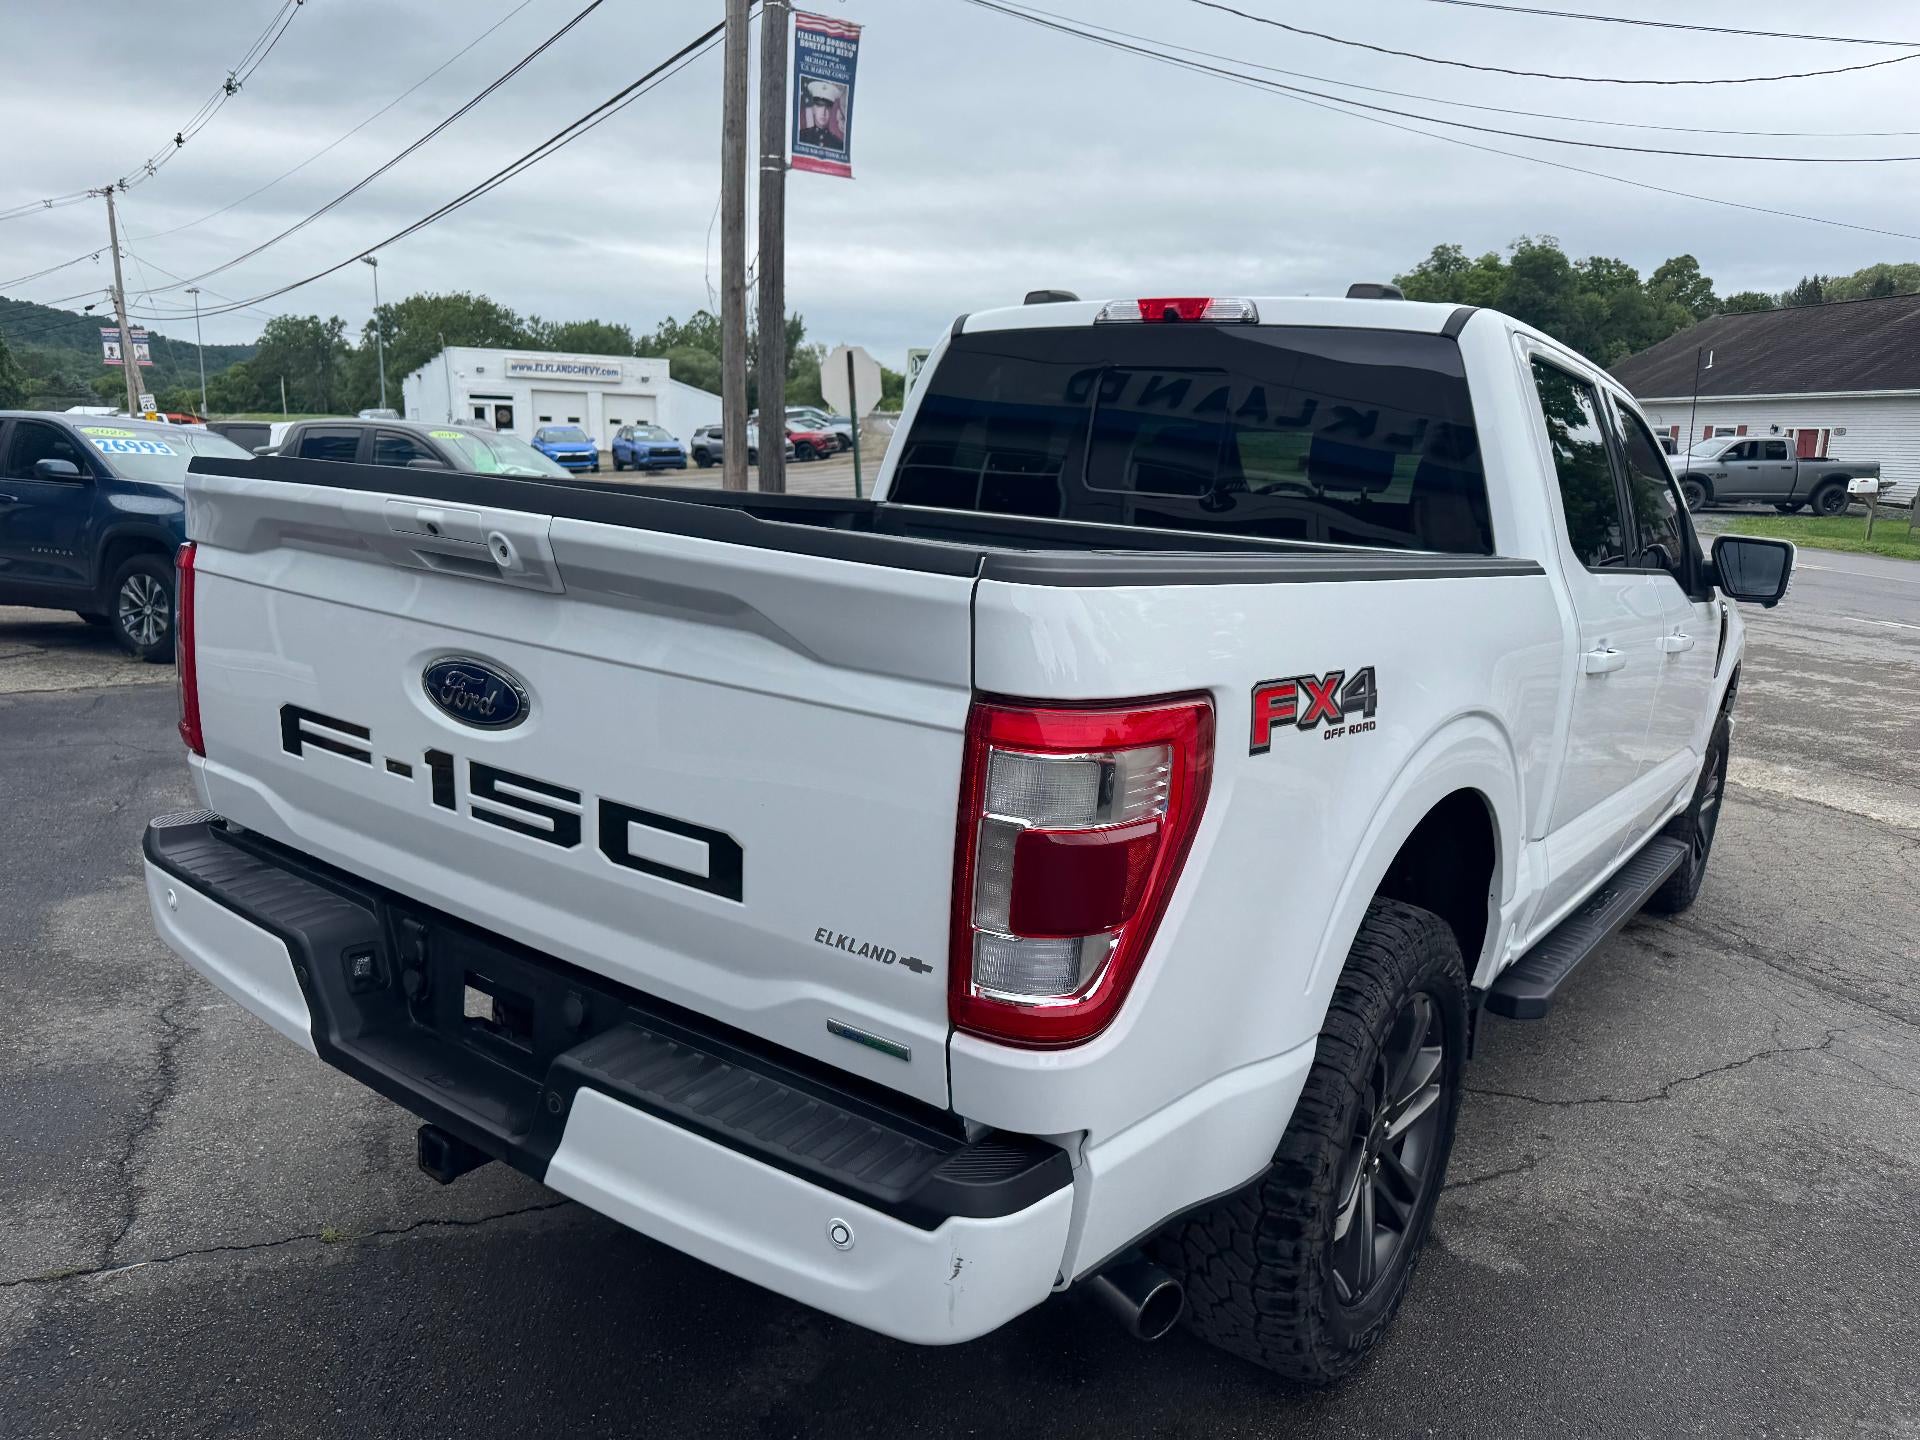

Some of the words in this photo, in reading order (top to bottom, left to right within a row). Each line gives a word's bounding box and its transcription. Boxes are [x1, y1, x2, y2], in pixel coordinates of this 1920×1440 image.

[799, 39, 835, 53] HOMETOWN
[511, 362, 619, 377] www.ELKLANDCHEVY.com
[143, 402, 156, 410] 40
[95, 439, 171, 455] 26995
[441, 671, 498, 716] Ford
[1249, 665, 1378, 757] FX4
[1323, 726, 1346, 741] OFF
[1348, 720, 1377, 736] ROAD
[279, 703, 744, 903] F-150
[814, 927, 897, 965] ELKLAND
